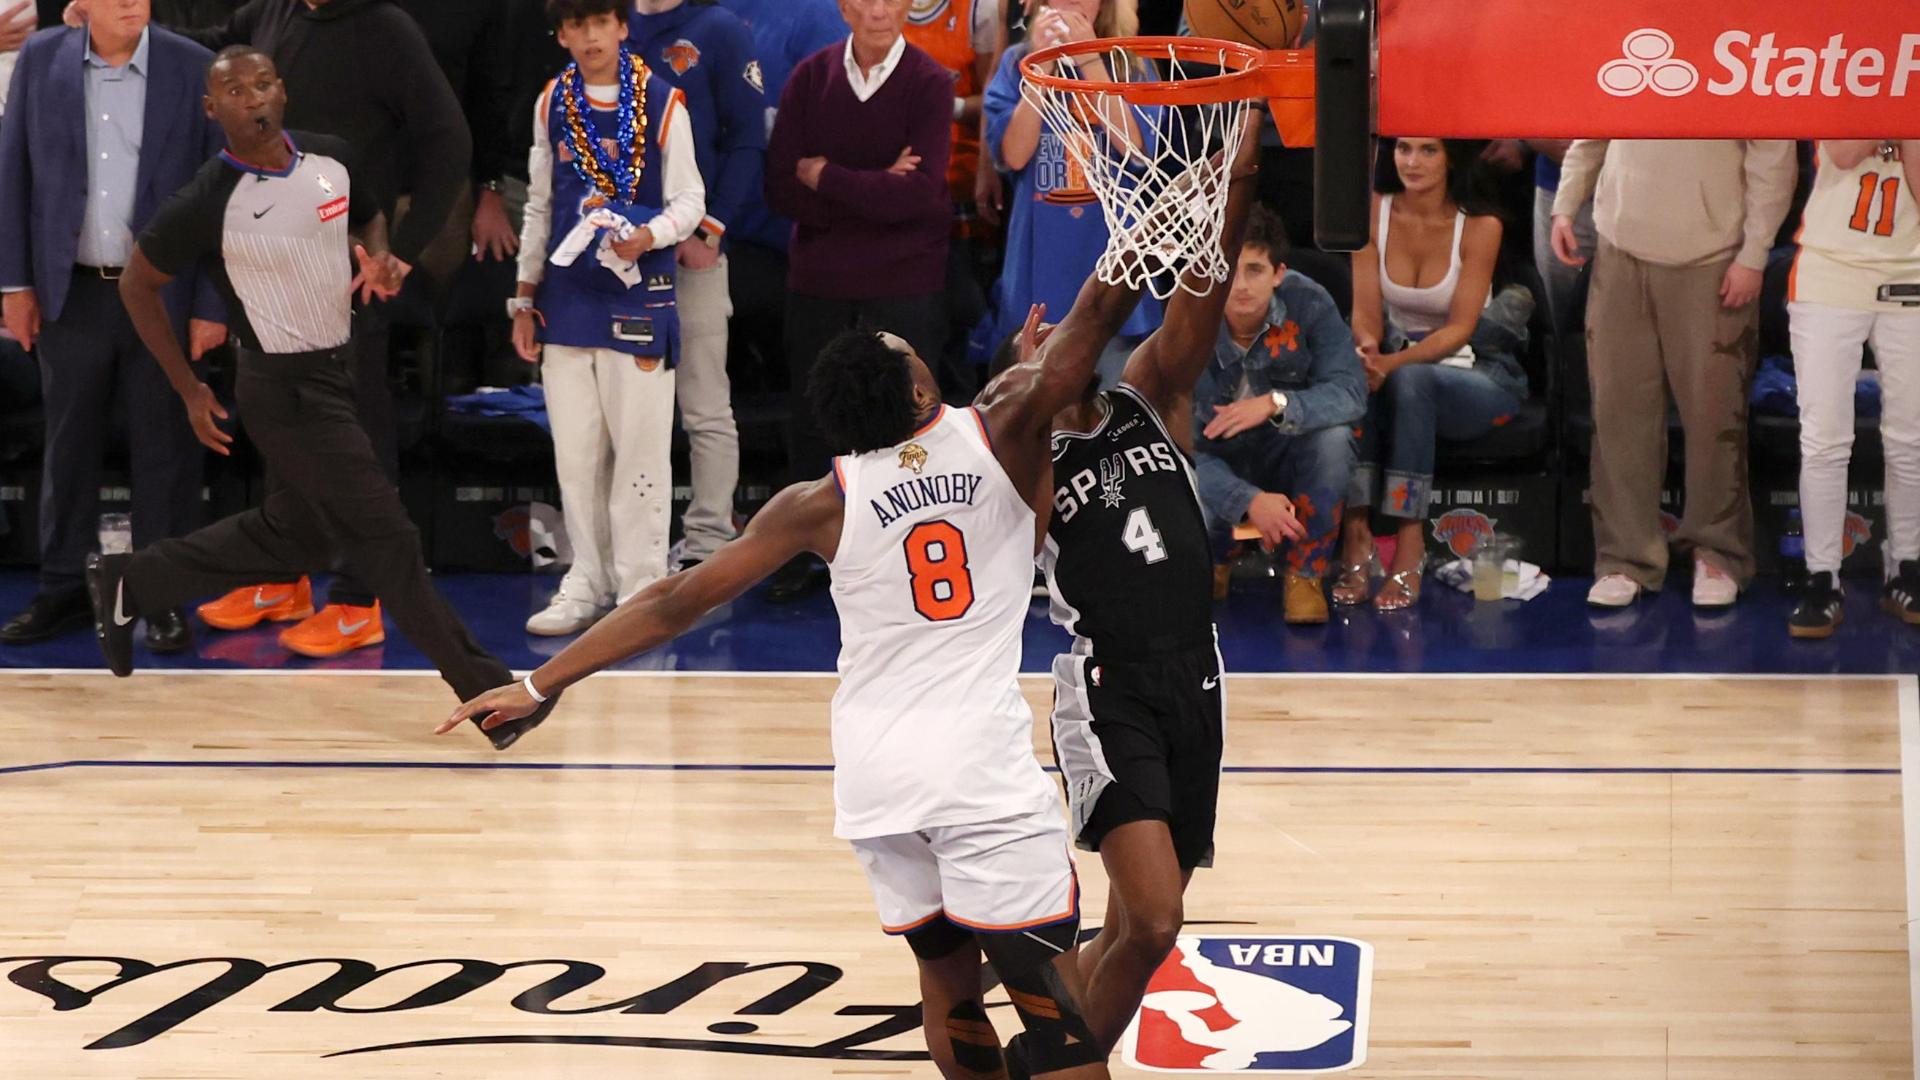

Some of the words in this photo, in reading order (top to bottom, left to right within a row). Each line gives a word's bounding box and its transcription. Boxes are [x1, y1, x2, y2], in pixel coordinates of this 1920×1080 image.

[1707, 30, 1885, 97] State
[1849, 171, 1900, 237] 11
[869, 473, 983, 528] ANUNOBY
[1053, 443, 1177, 523] SPURS
[1121, 505, 1169, 565] 4
[903, 519, 975, 622] 8
[1228, 943, 1335, 967] NBA
